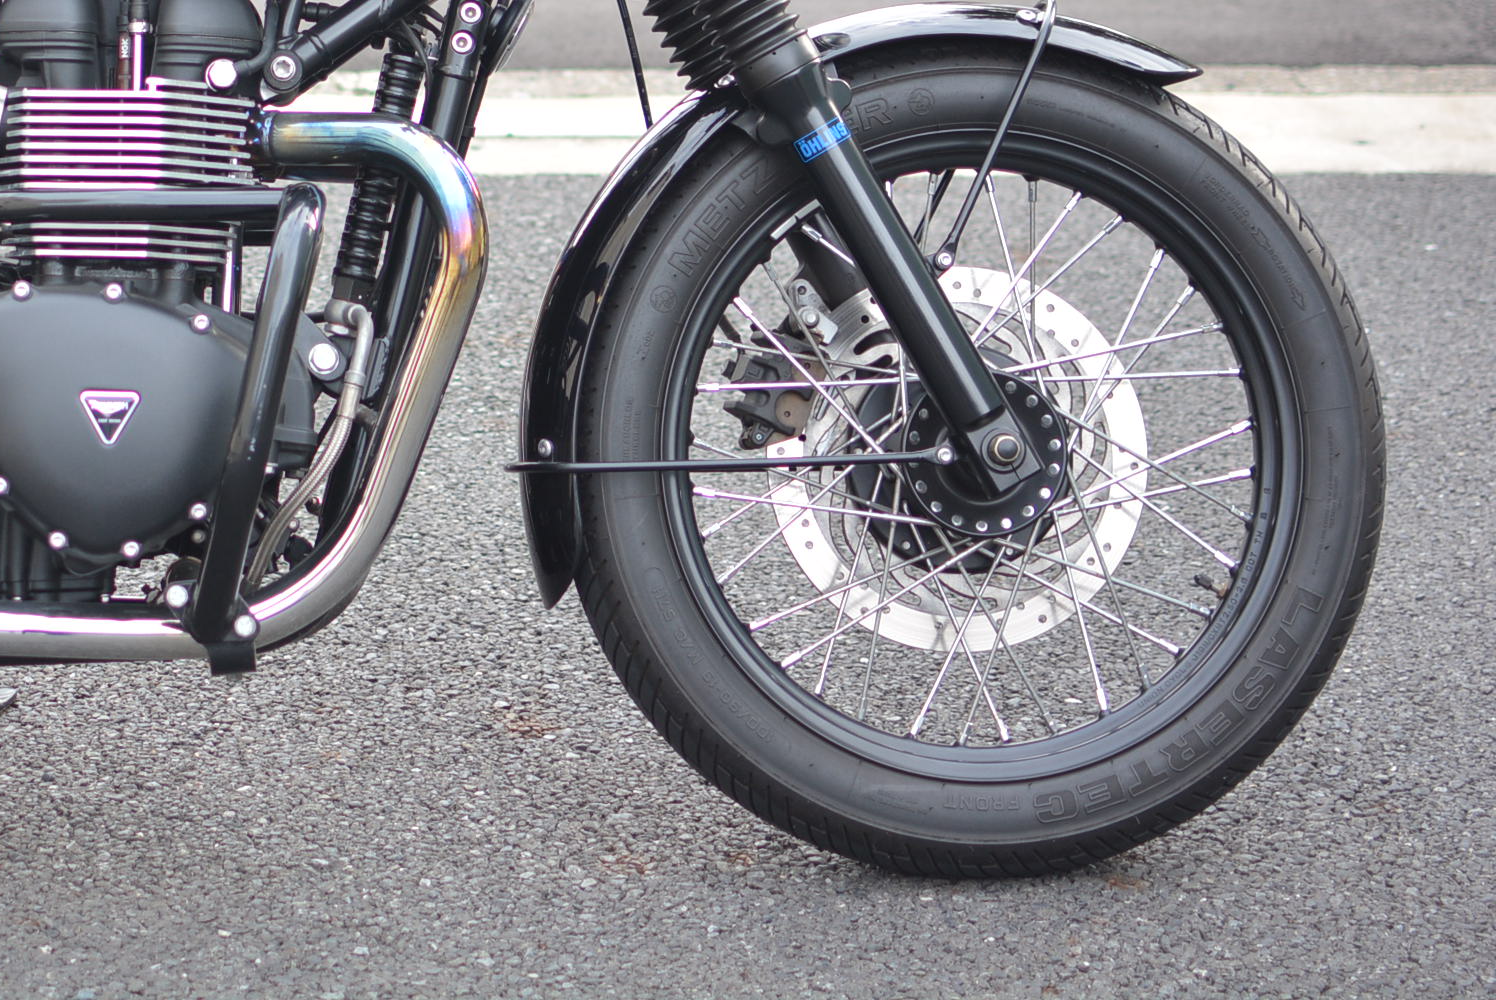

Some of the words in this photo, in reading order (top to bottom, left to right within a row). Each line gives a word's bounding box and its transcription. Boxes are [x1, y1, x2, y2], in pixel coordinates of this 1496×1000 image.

[799, 120, 849, 158] ÖHLINS
[1034, 586, 1323, 824] LASERTEC
[942, 793, 1023, 813] FRONT
